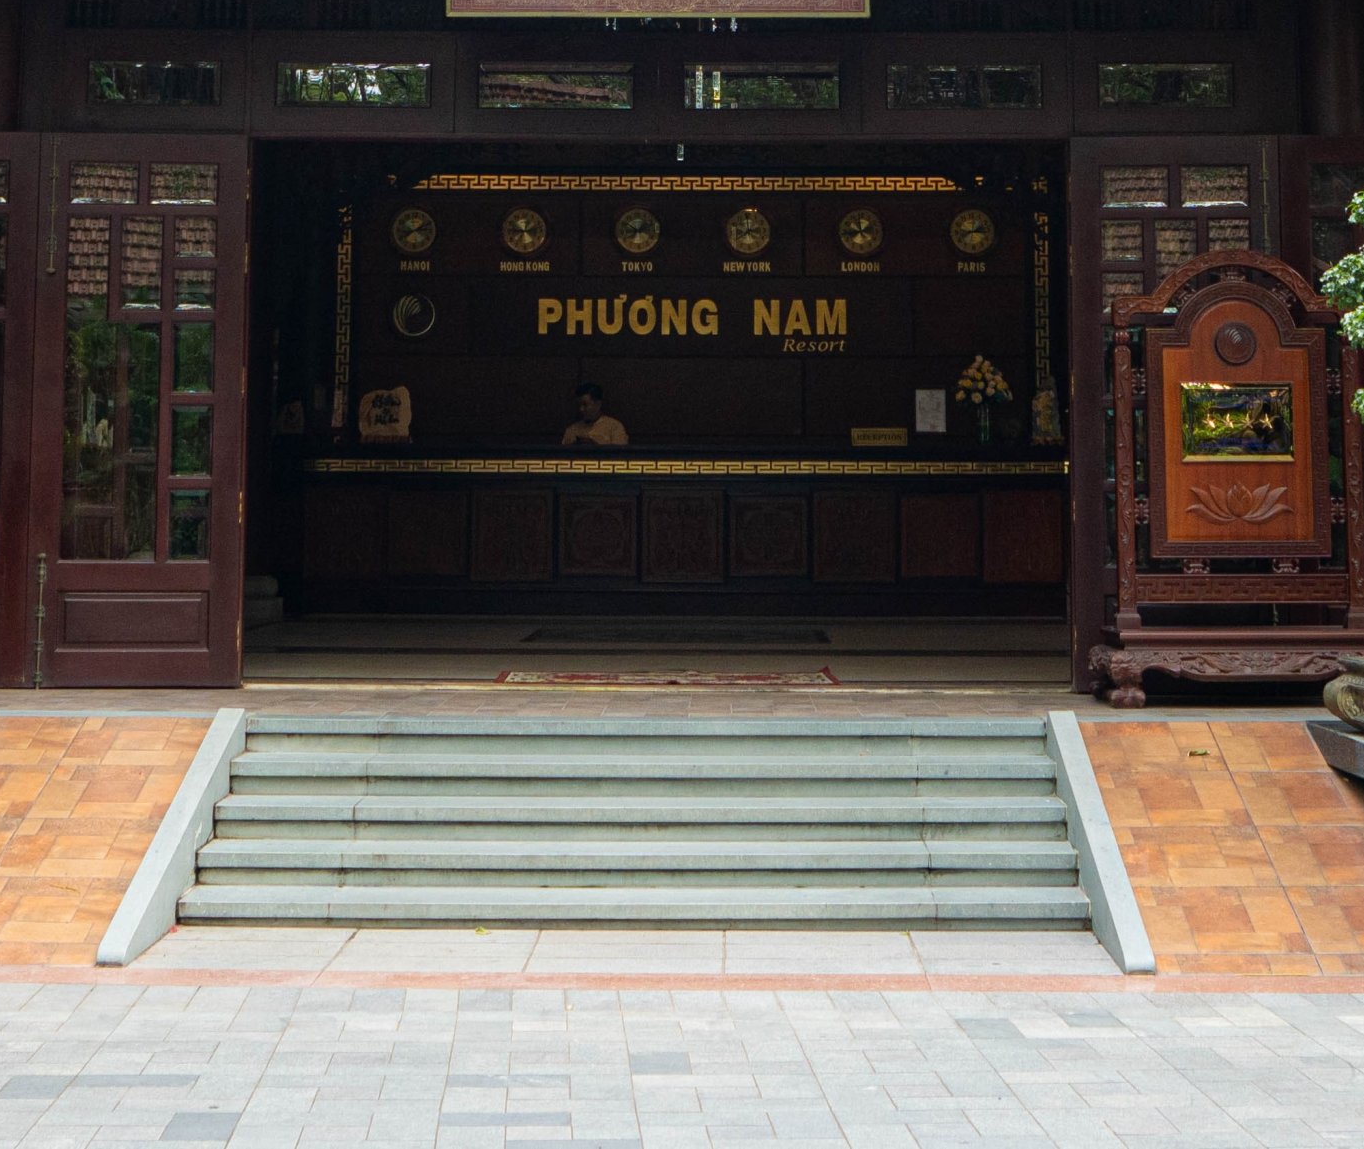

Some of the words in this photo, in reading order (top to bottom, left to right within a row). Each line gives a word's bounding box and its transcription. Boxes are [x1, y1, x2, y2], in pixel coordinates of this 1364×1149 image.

[400, 260, 430, 272] HANOI
[499, 260, 525, 273] HONG
[525, 260, 550, 273] KONG
[621, 260, 653, 273] TOKYO
[722, 260, 746, 273] NEW
[745, 260, 771, 273] YORK
[840, 260, 881, 273] LONDON
[957, 261, 986, 273] PARIS
[538, 293, 719, 336] PHƯƠNG
[753, 299, 847, 336] NAM
[783, 338, 847, 353] Resort
[856, 433, 902, 441] RECEPTION
